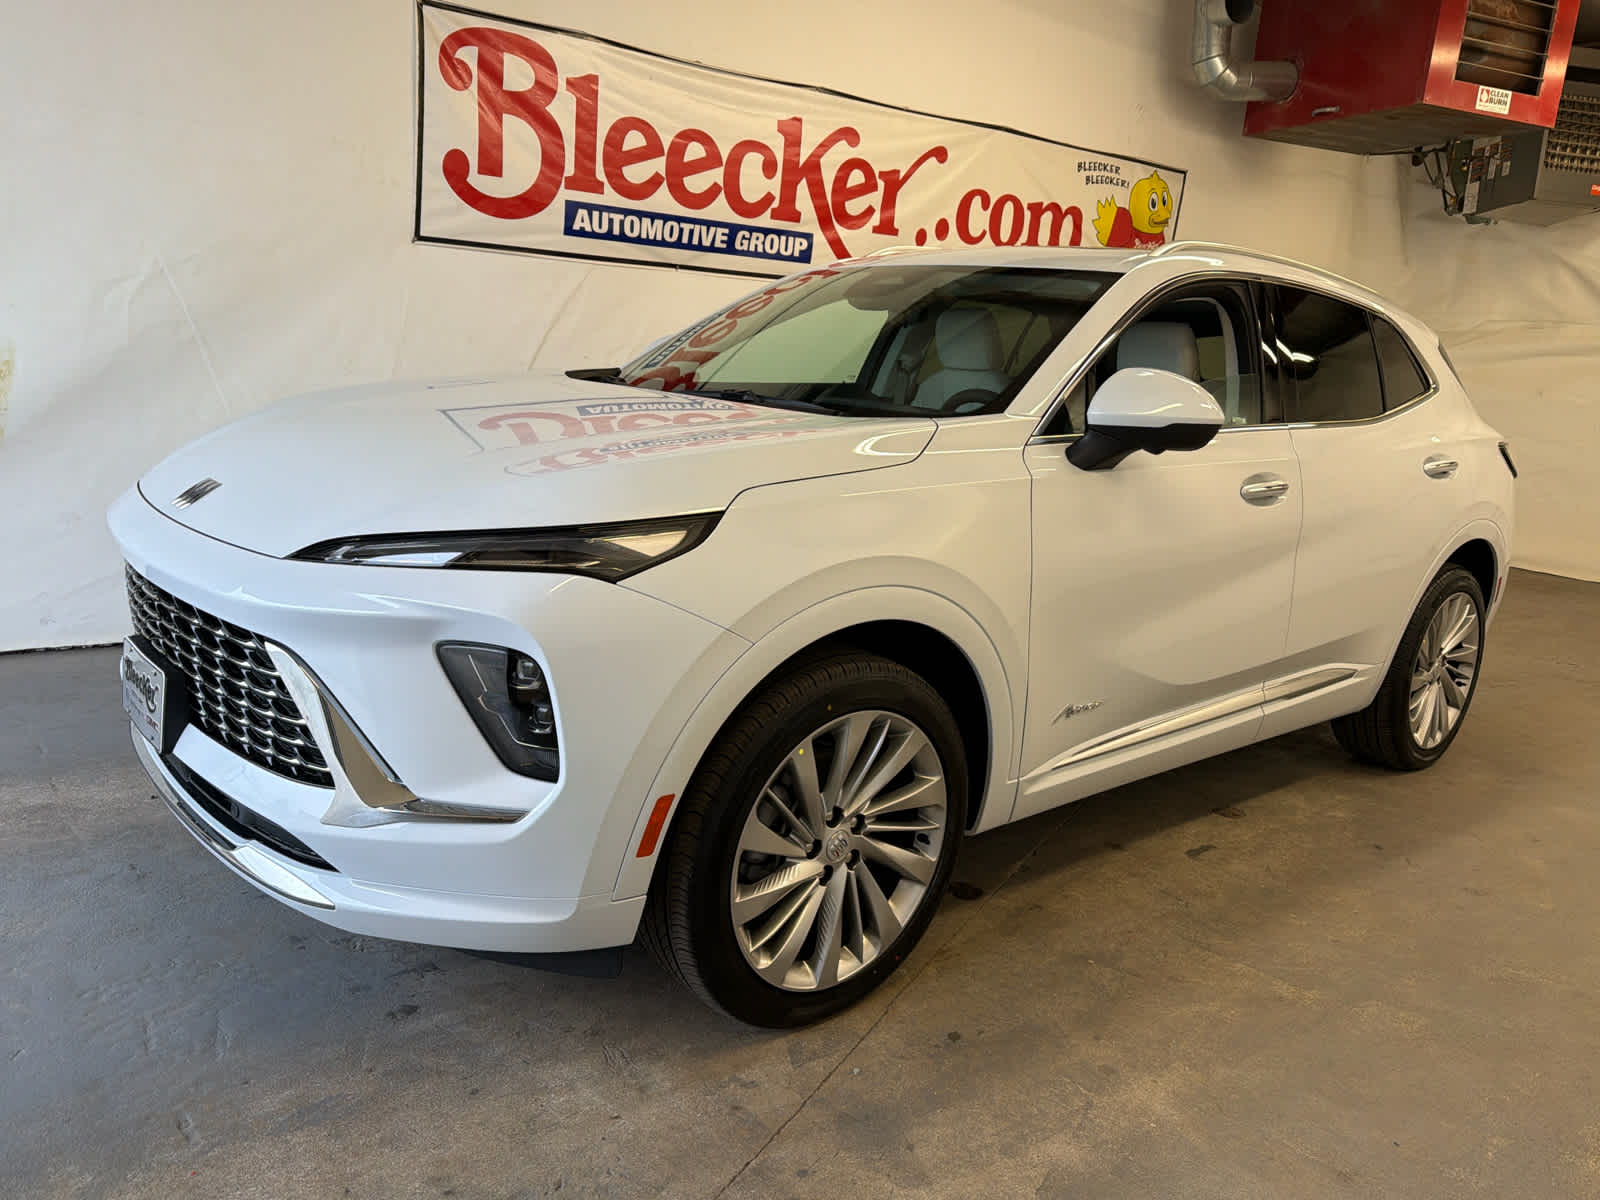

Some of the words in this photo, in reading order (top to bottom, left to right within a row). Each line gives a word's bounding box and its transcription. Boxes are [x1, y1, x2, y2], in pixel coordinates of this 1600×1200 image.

[1491, 90, 1509, 98] CLEAN
[1489, 97, 1507, 106] BURN
[1077, 161, 1121, 175] BLEECKER
[1085, 174, 1130, 189] BLEECKER!
[572, 208, 728, 249] AUTOMOTIVE
[734, 230, 809, 258] GROUP
